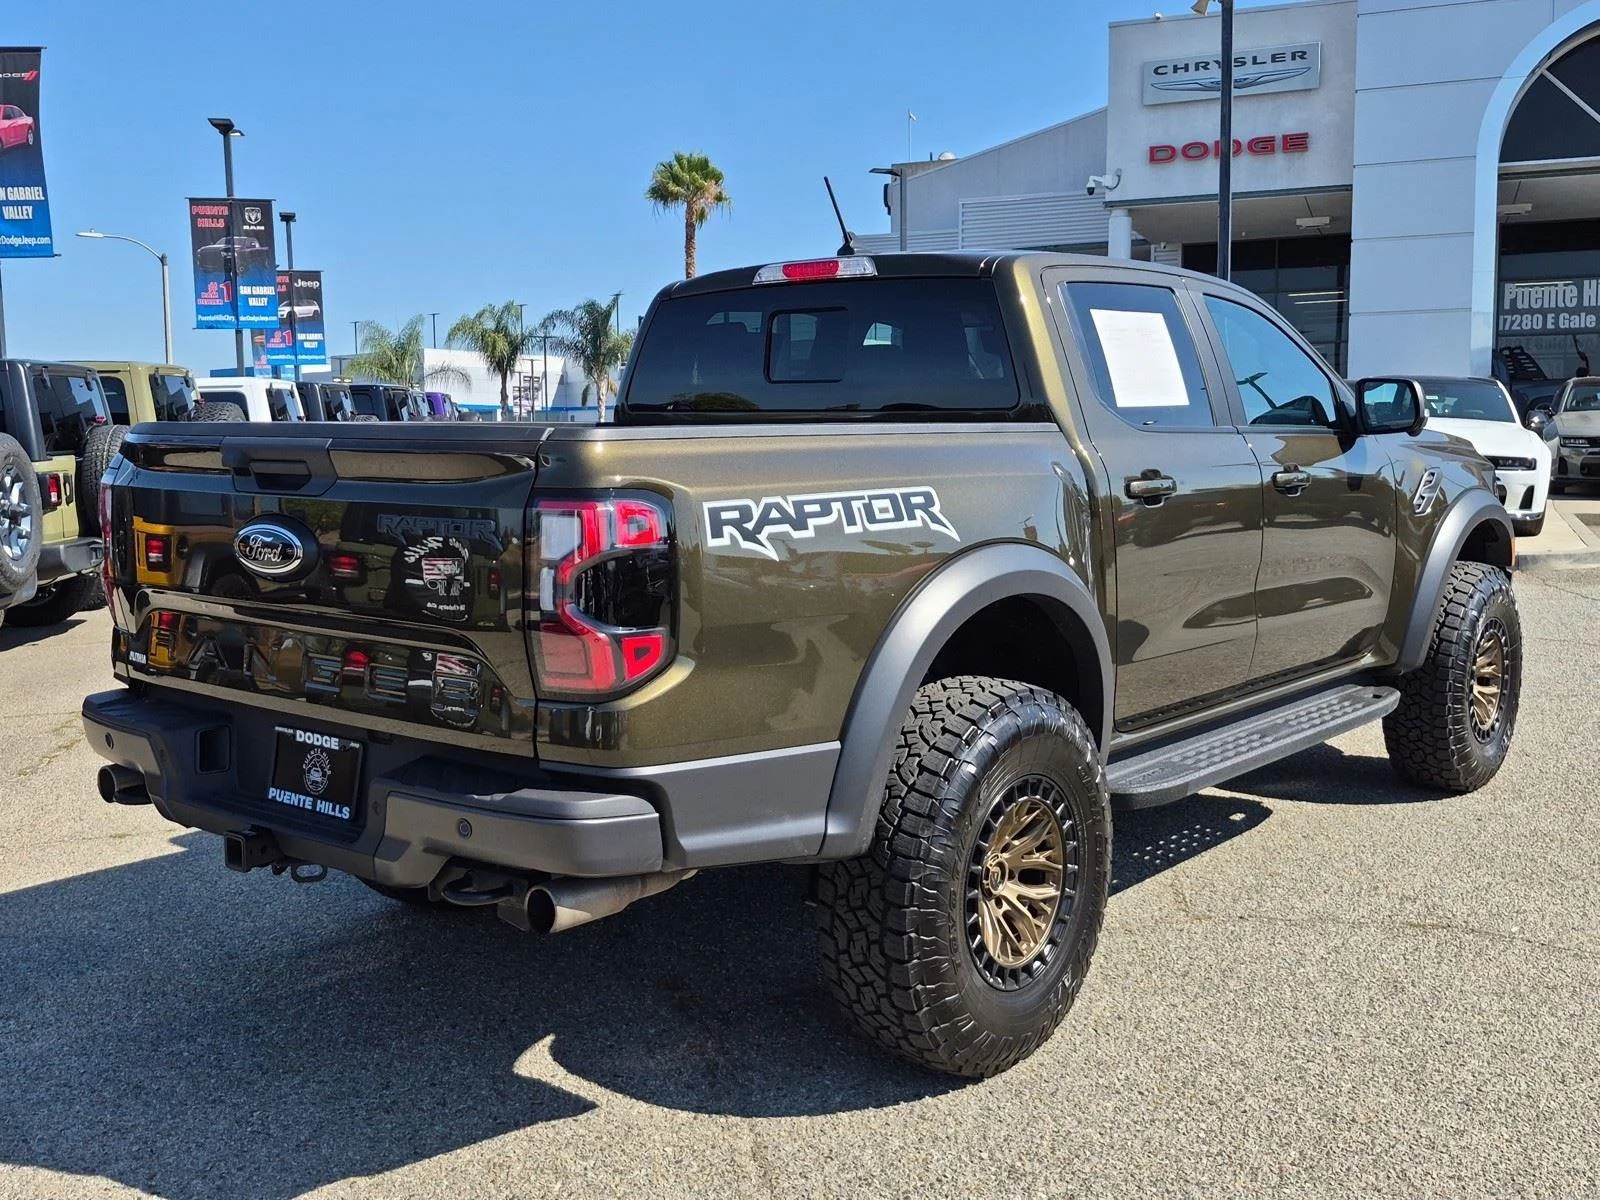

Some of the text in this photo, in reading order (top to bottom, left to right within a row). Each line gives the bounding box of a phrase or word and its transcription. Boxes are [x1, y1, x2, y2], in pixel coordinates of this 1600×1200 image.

[1149, 132, 1309, 164] DODGE
[7, 186, 45, 200] GABRIEL
[2, 206, 33, 219] VALLEY
[294, 278, 320, 289] Jeep
[1503, 283, 1578, 310] Puente
[1498, 312, 1597, 331] 17280 E Gale
[377, 513, 504, 551] RAPTOR
[702, 485, 961, 562] RAPTOR
[245, 533, 283, 562] Ford
[296, 730, 339, 750] DODGE
[268, 787, 350, 819] PUENTE HILLS
